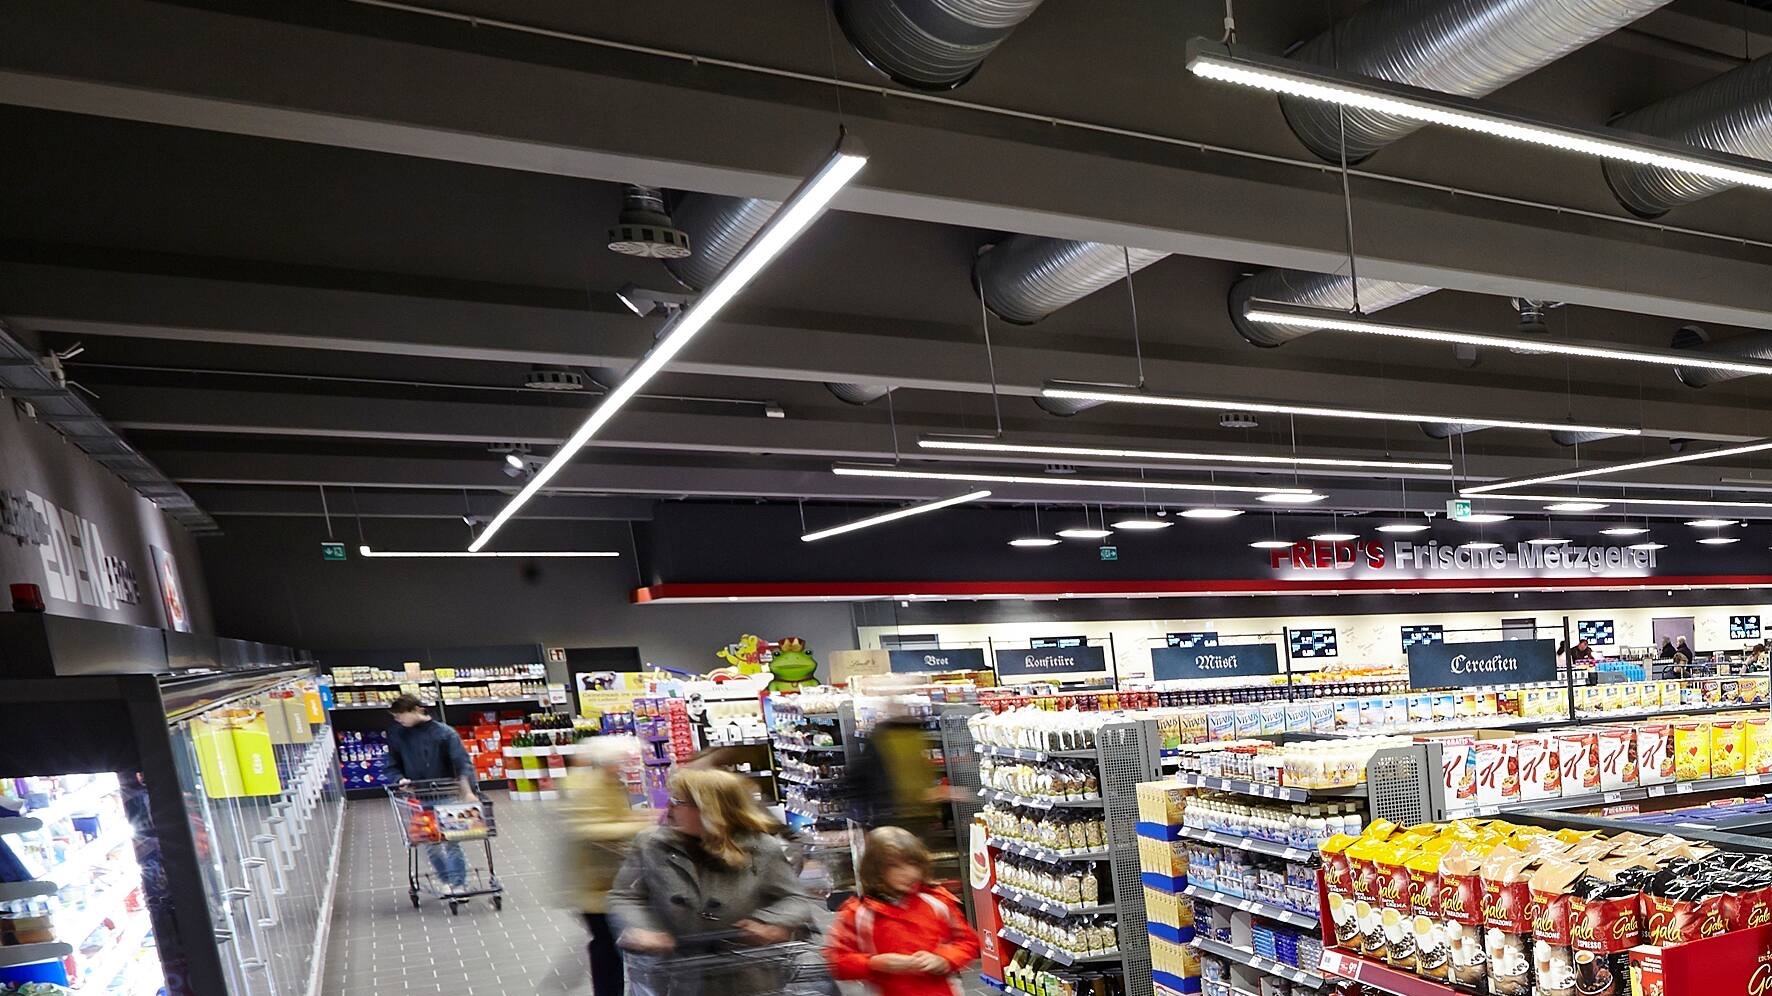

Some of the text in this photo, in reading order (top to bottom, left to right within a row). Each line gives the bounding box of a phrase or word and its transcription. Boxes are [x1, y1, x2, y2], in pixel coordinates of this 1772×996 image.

[1270, 540, 1657, 573] FRED'S Frische-Metzgerei
[924, 655, 949, 667] Brot
[1024, 655, 1075, 670] Konfitüre
[1450, 654, 1518, 674] Cerealien
[1439, 887, 1464, 917] Gala
[1480, 894, 1508, 924] Gala
[1531, 904, 1555, 934] Gala
[1570, 912, 1595, 944] Gala
[1613, 916, 1638, 940] Gala
[1649, 912, 1681, 946] Gala
